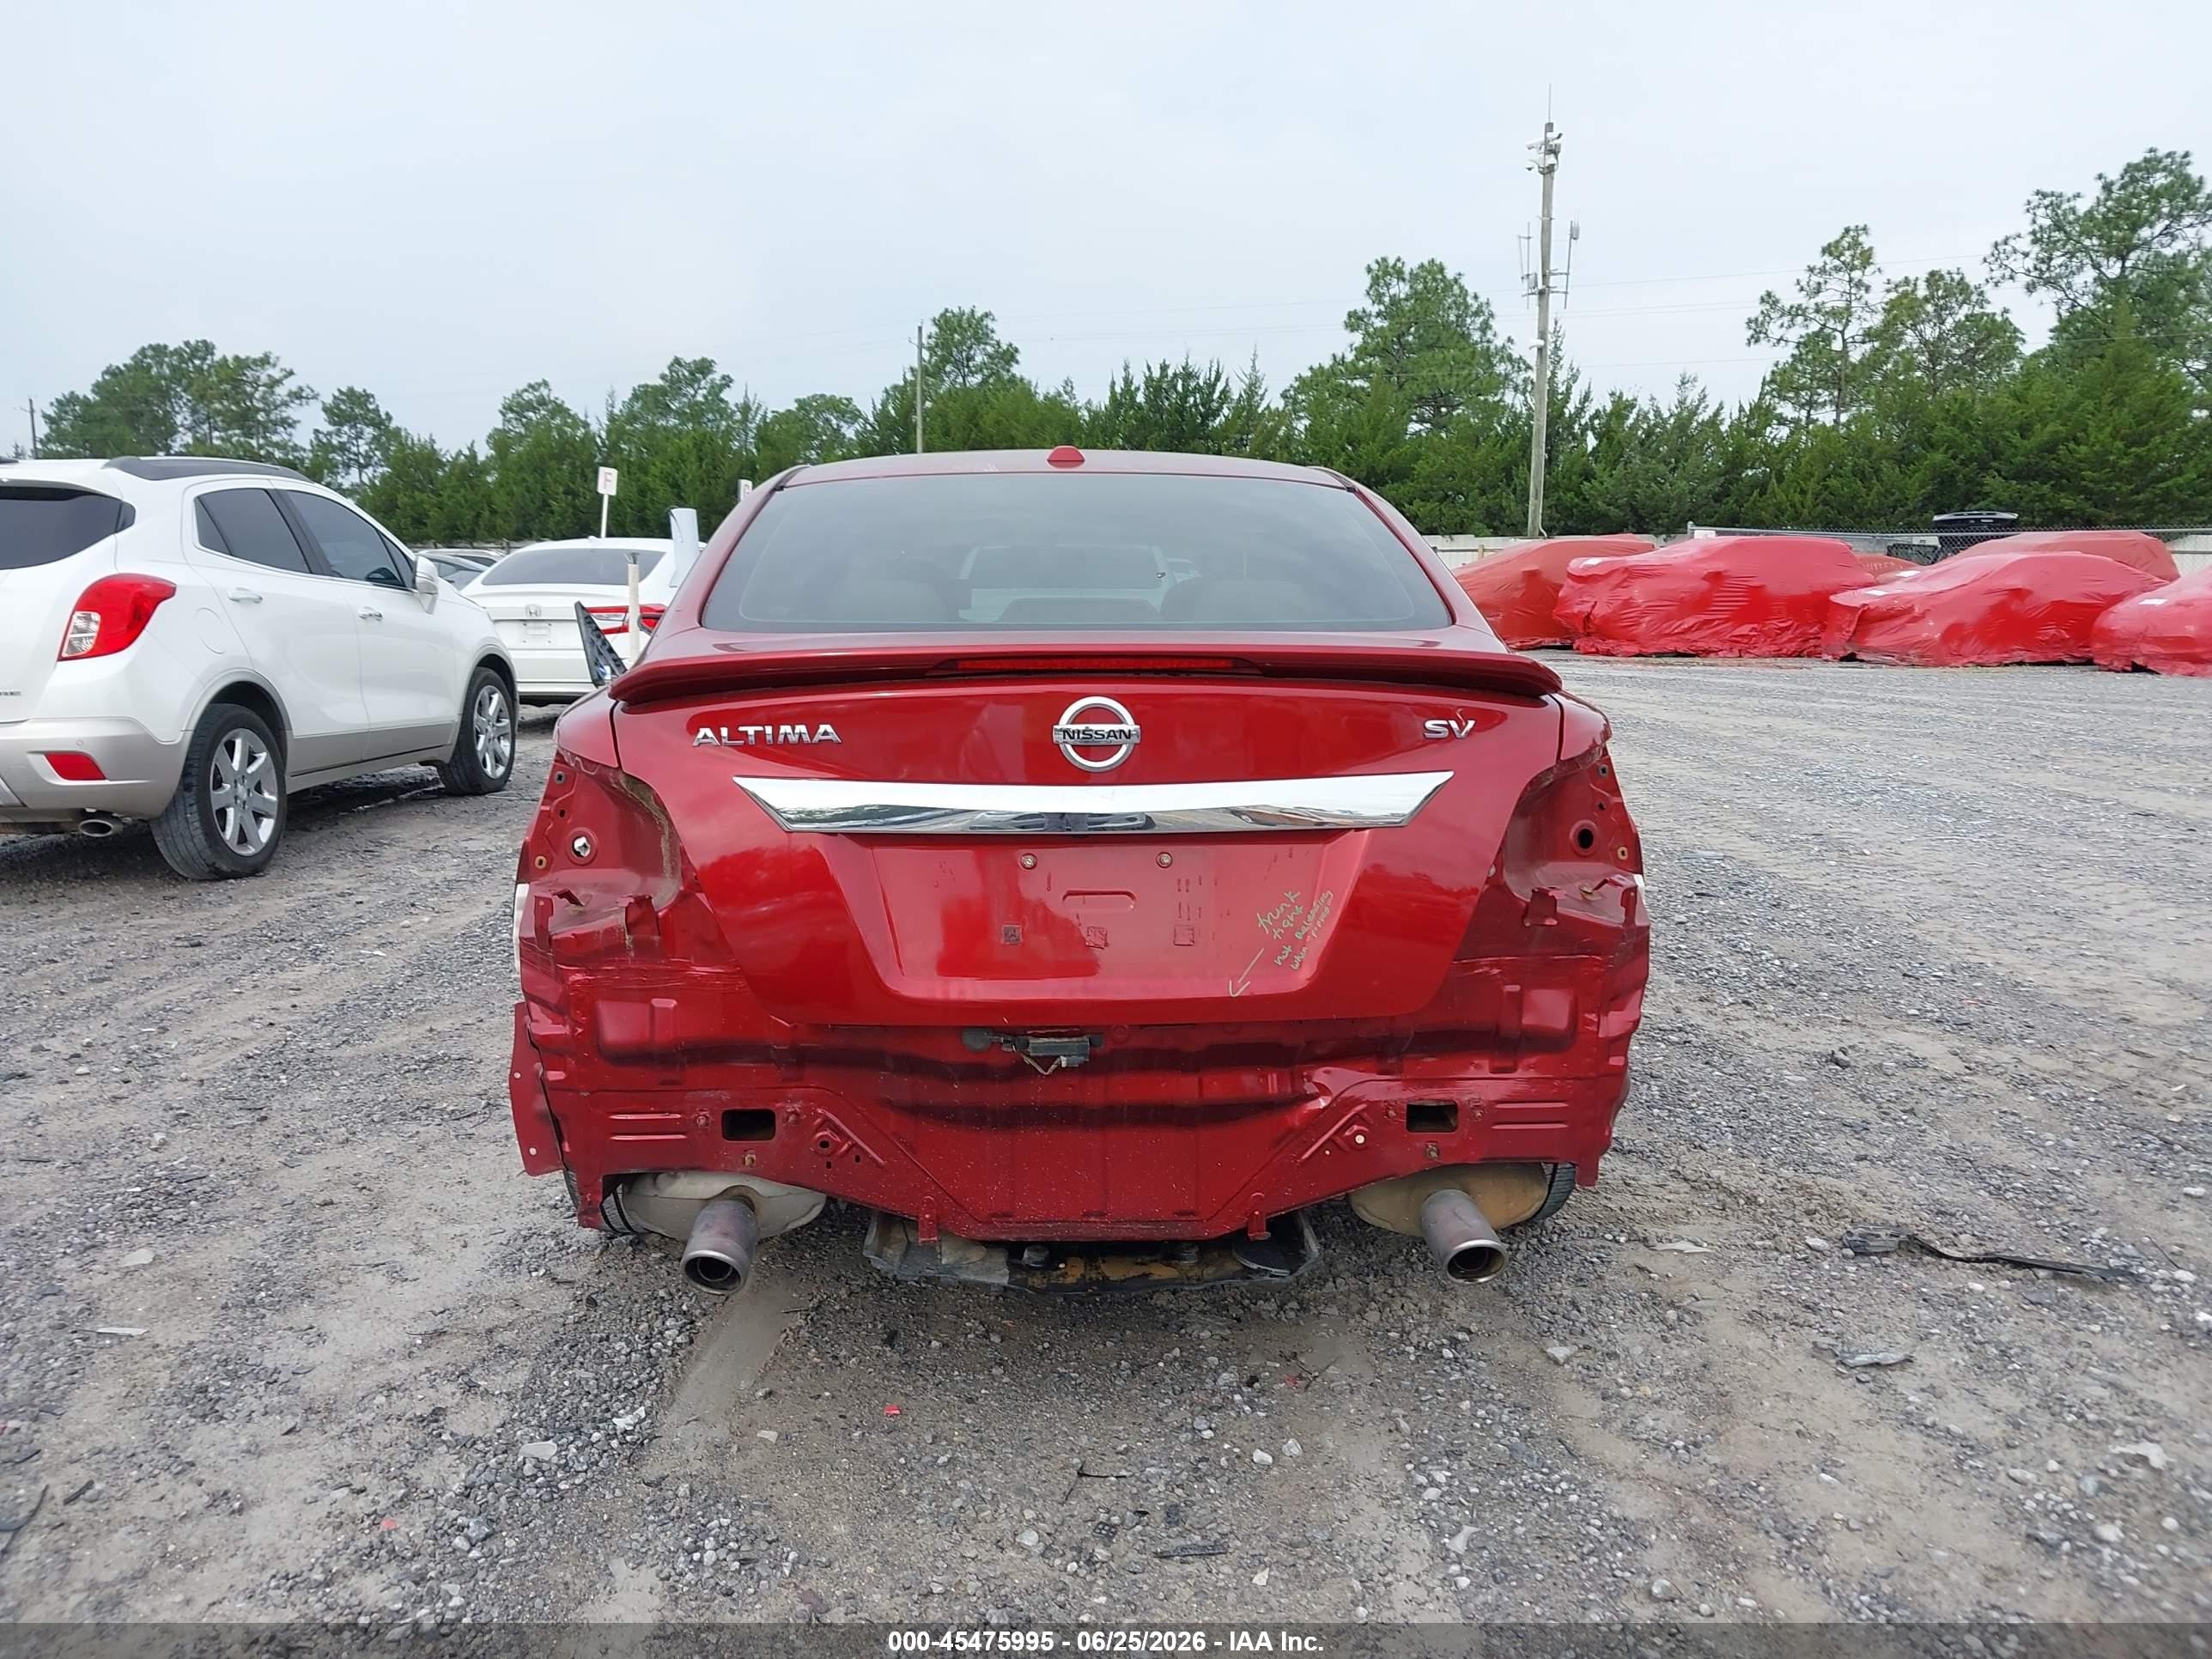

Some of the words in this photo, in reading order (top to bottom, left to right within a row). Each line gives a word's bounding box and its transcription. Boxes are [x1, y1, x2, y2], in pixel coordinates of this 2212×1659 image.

[604, 471, 612, 489] F
[692, 723, 842, 747] ALTIMA
[1061, 728, 1133, 742] NISSAN
[1423, 720, 1476, 738] SV
